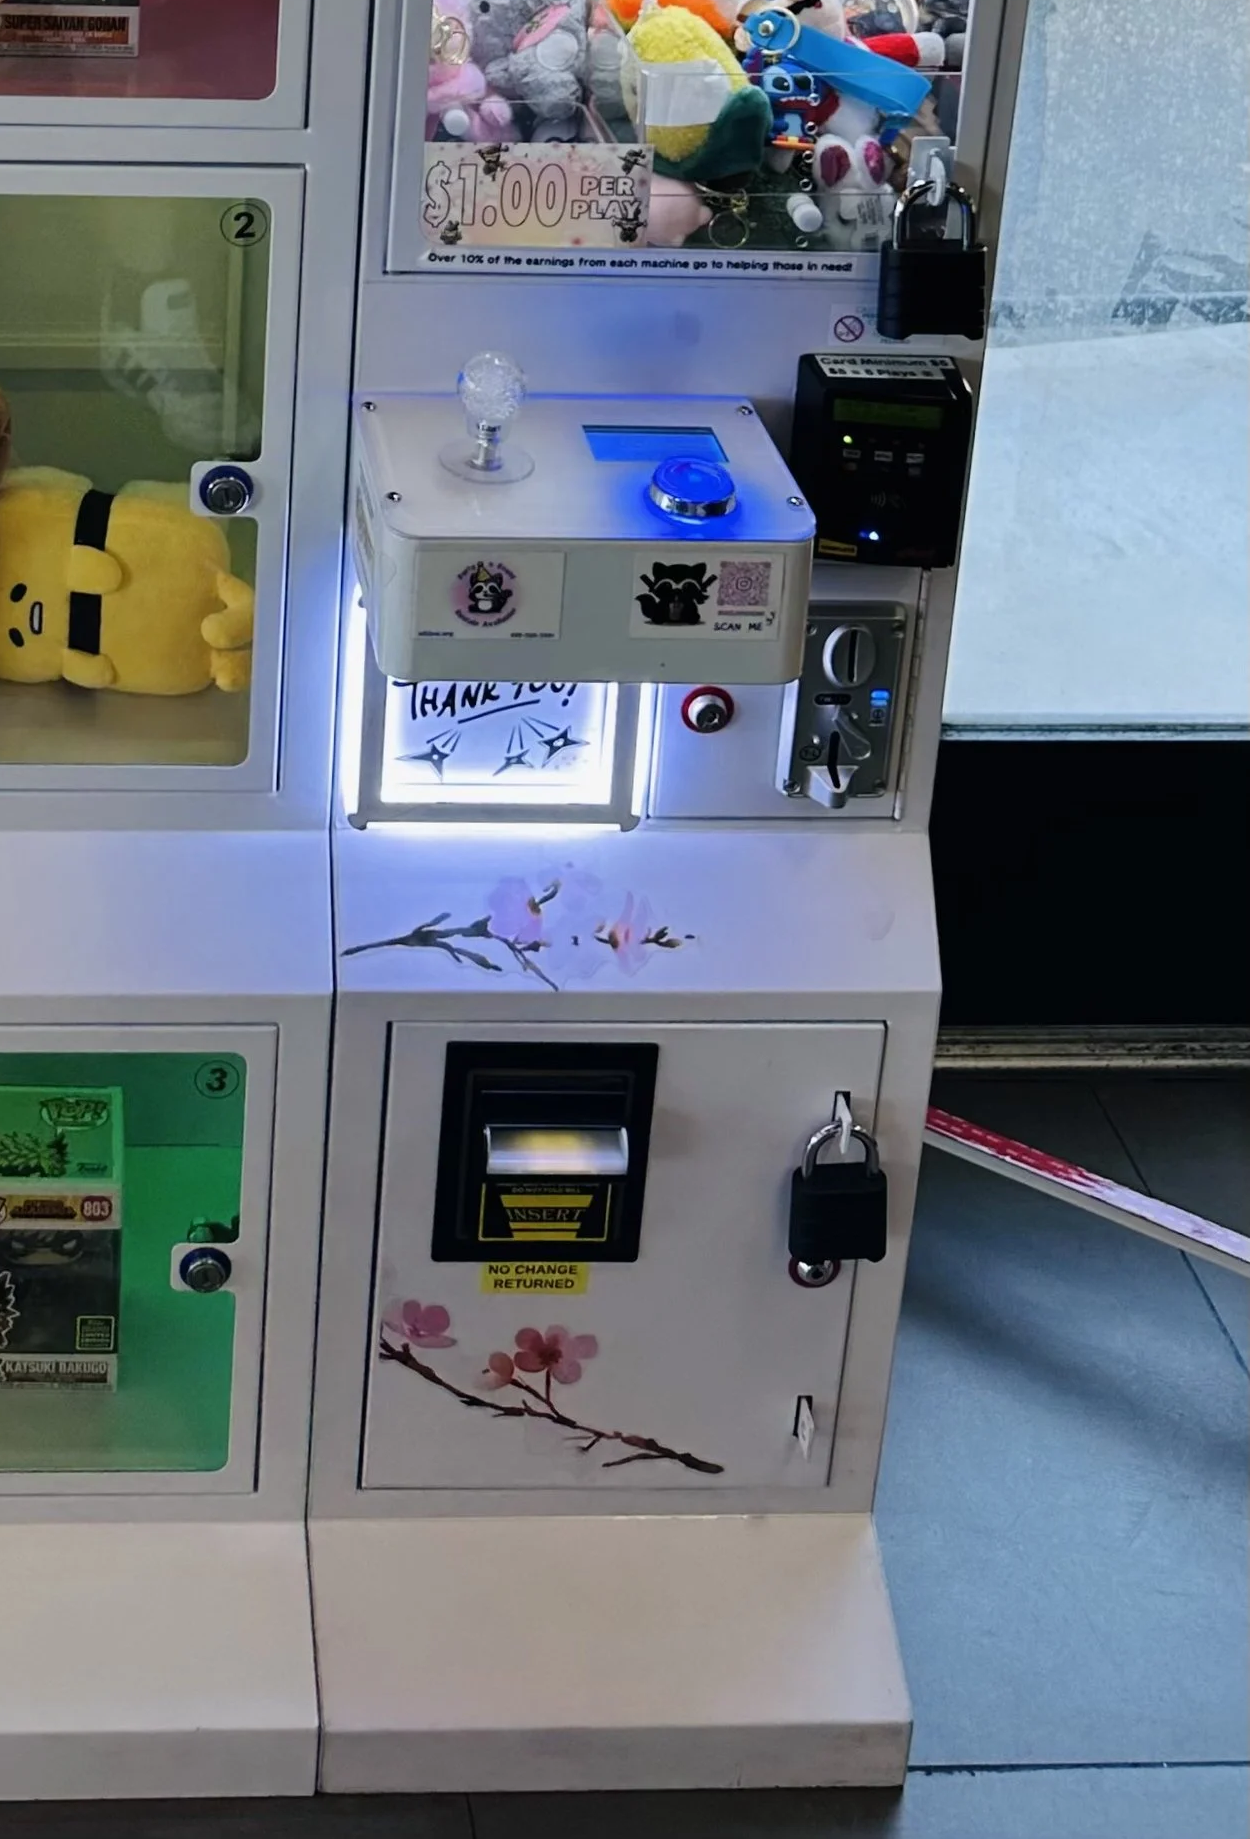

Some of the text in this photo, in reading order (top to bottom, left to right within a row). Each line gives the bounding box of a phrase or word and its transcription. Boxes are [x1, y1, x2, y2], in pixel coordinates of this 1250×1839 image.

[4, 16, 43, 30] SUPER
[44, 16, 86, 31] SAIYAN
[423, 161, 636, 229] $1.00 PER
[571, 199, 642, 222] PLAY
[232, 212, 257, 239] 2
[427, 251, 853, 272] Over 10% of the earnings from each machine go to helping those in need!
[713, 622, 763, 631] SCAN ME
[392, 681, 500, 720] THANK
[205, 1067, 229, 1092] 3
[83, 1200, 111, 1217] 803
[506, 1208, 586, 1221] INSERT
[488, 1264, 578, 1275] NO CHANGE
[493, 1278, 575, 1289] RETURNED
[4, 1361, 109, 1376] KATSUKI BAKUGO
